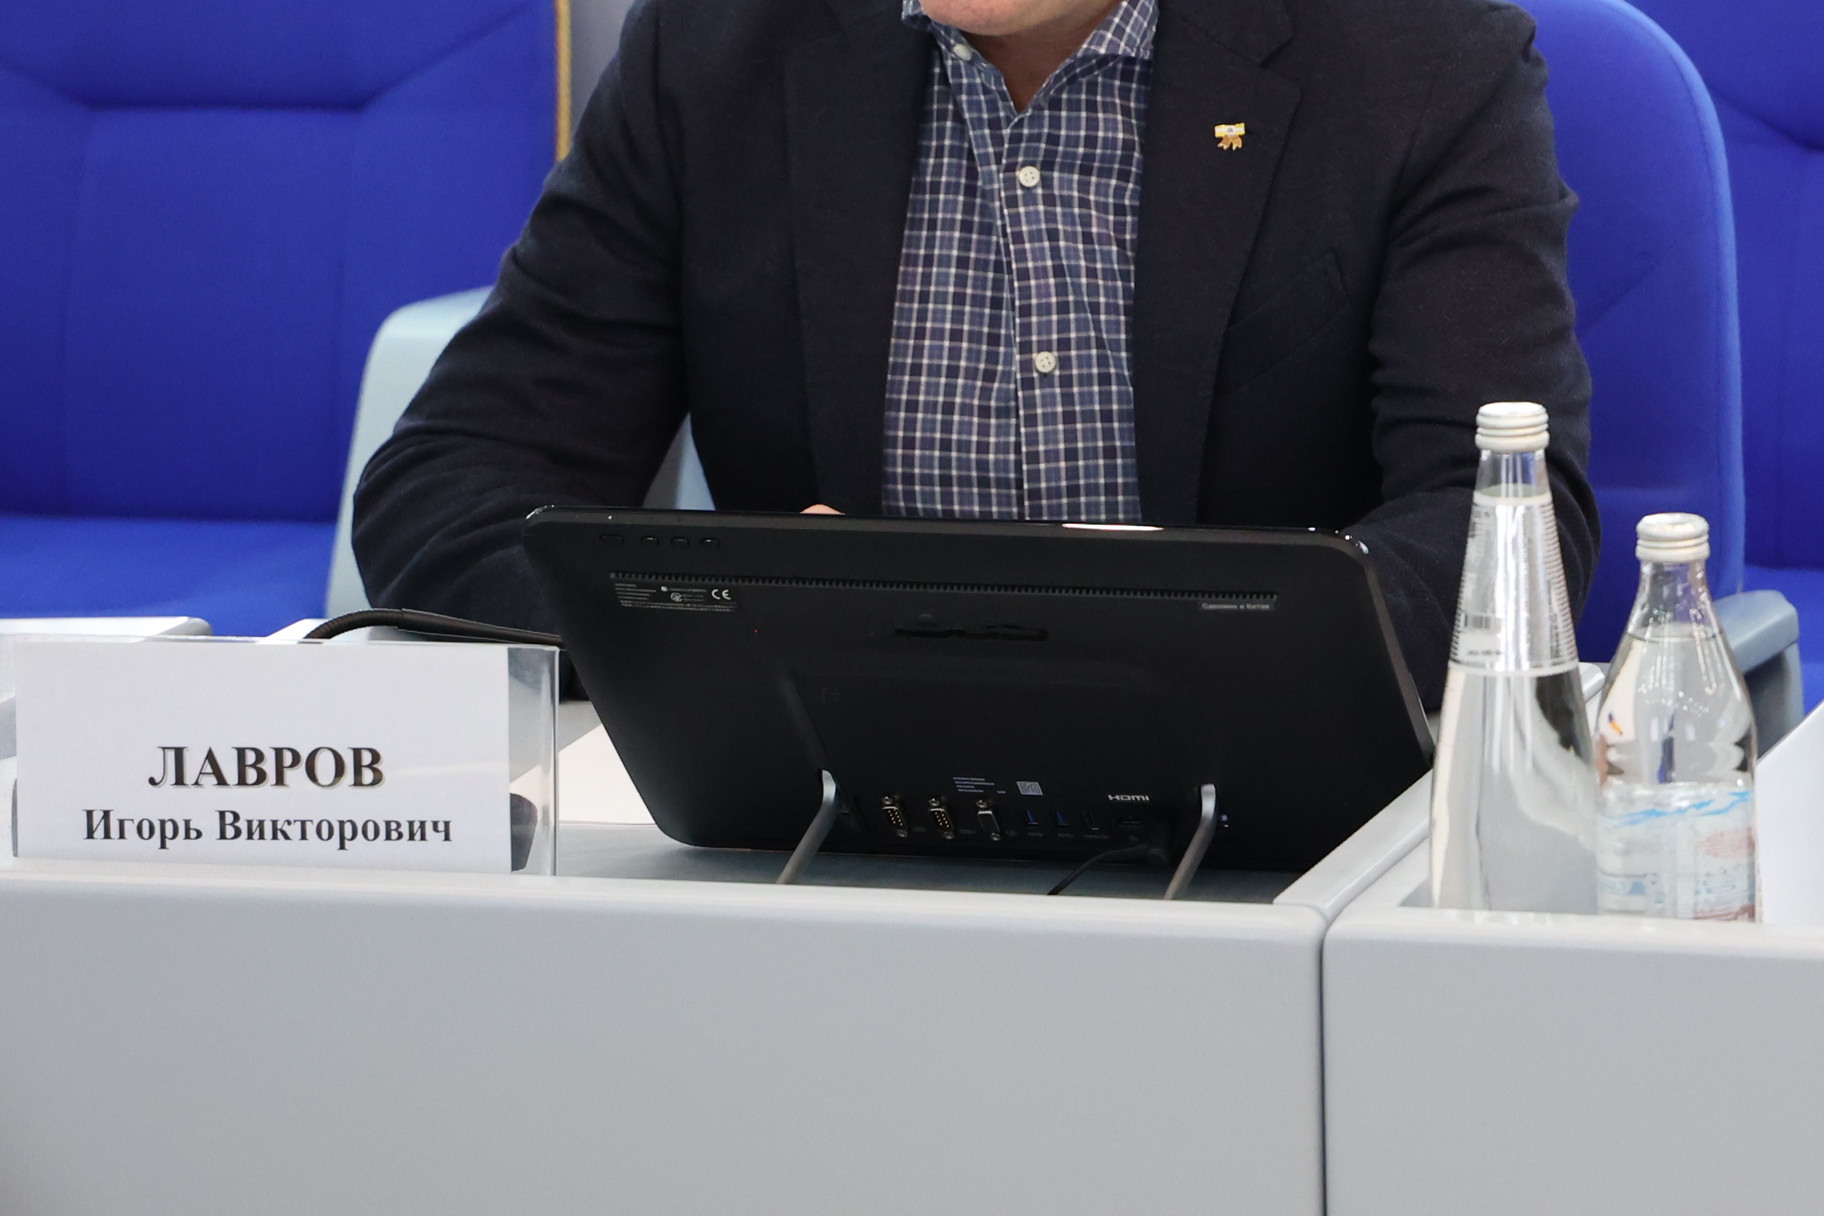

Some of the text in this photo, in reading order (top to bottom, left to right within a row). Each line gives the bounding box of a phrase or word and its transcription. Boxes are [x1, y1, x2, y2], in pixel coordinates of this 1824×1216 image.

[147, 746, 384, 788] ЛАВРОВ
[82, 809, 453, 851] Игорь Викторович
